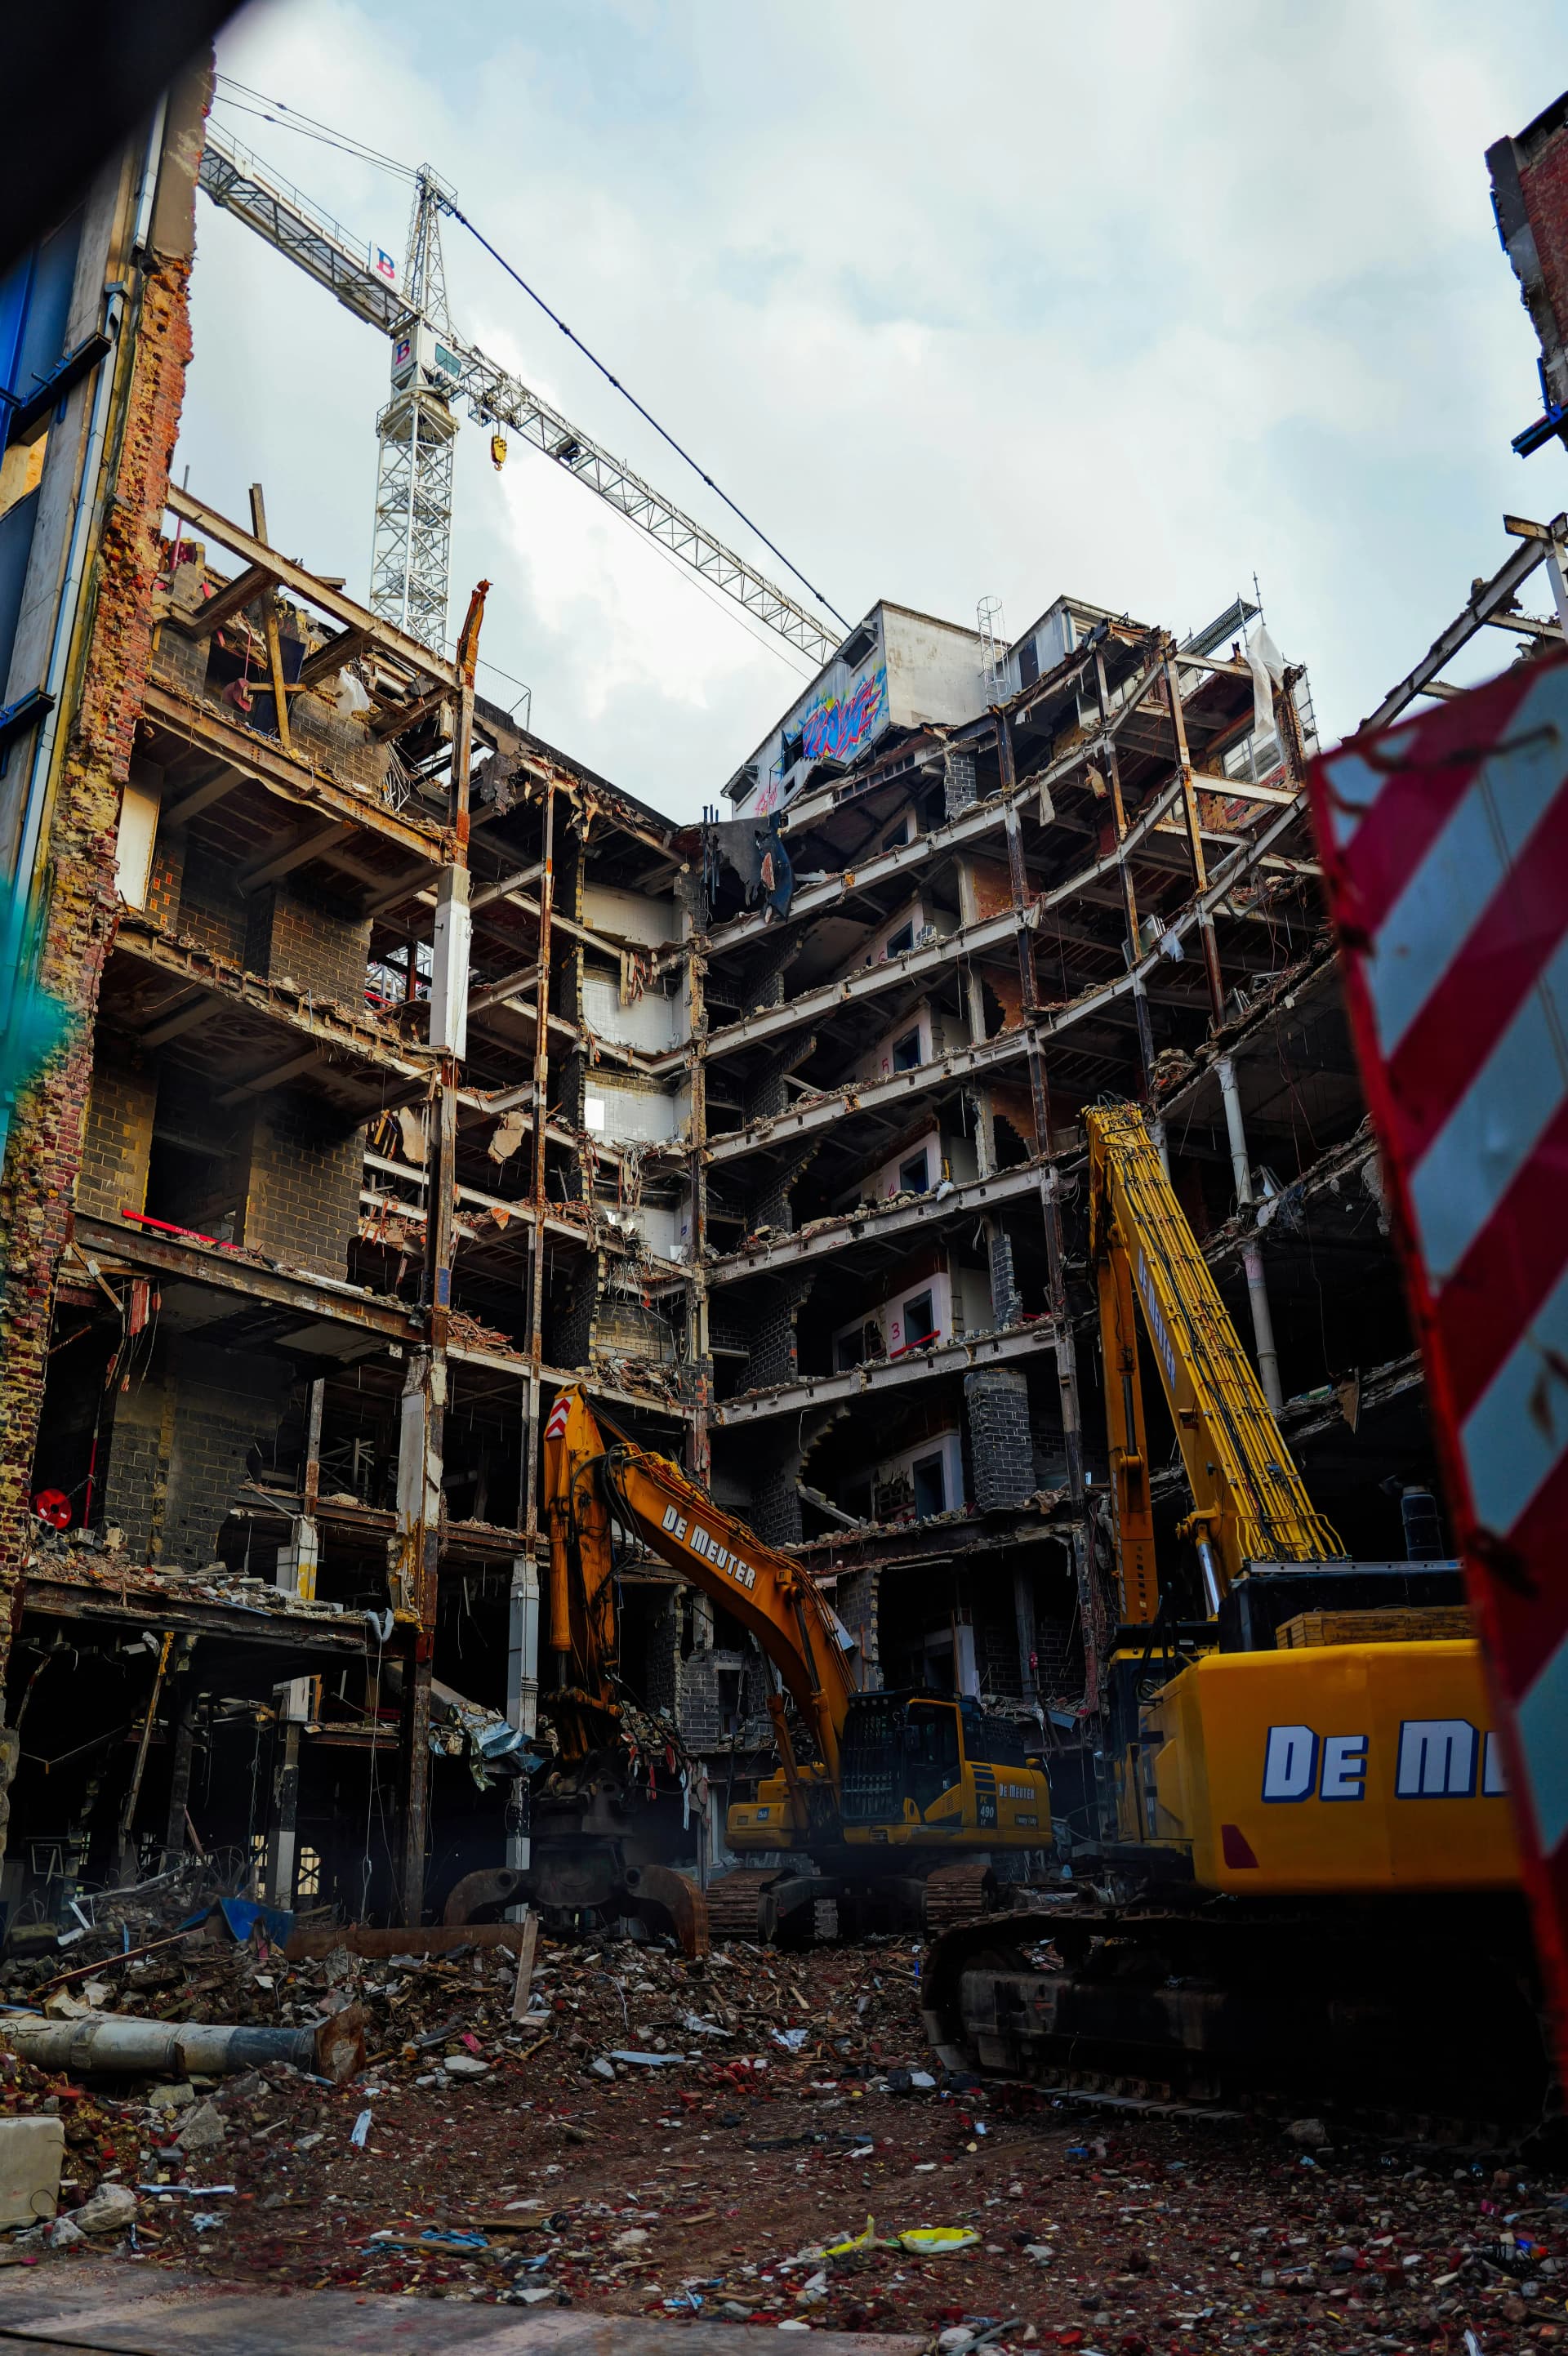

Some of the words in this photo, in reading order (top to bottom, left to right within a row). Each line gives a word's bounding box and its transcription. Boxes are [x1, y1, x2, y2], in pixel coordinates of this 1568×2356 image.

[376, 247, 395, 279] B
[395, 338, 411, 366] B
[891, 1322, 901, 1340] 3
[1138, 1247, 1147, 1297] DE
[1147, 1276, 1176, 1391] MEUTER
[662, 1503, 688, 1542] DE
[689, 1524, 756, 1591] MEUTER
[1261, 1725, 1370, 1803] DE
[999, 1783, 1008, 1797] DE
[1010, 1784, 1035, 1799] MEUTER
[980, 1805, 995, 1818] 490
